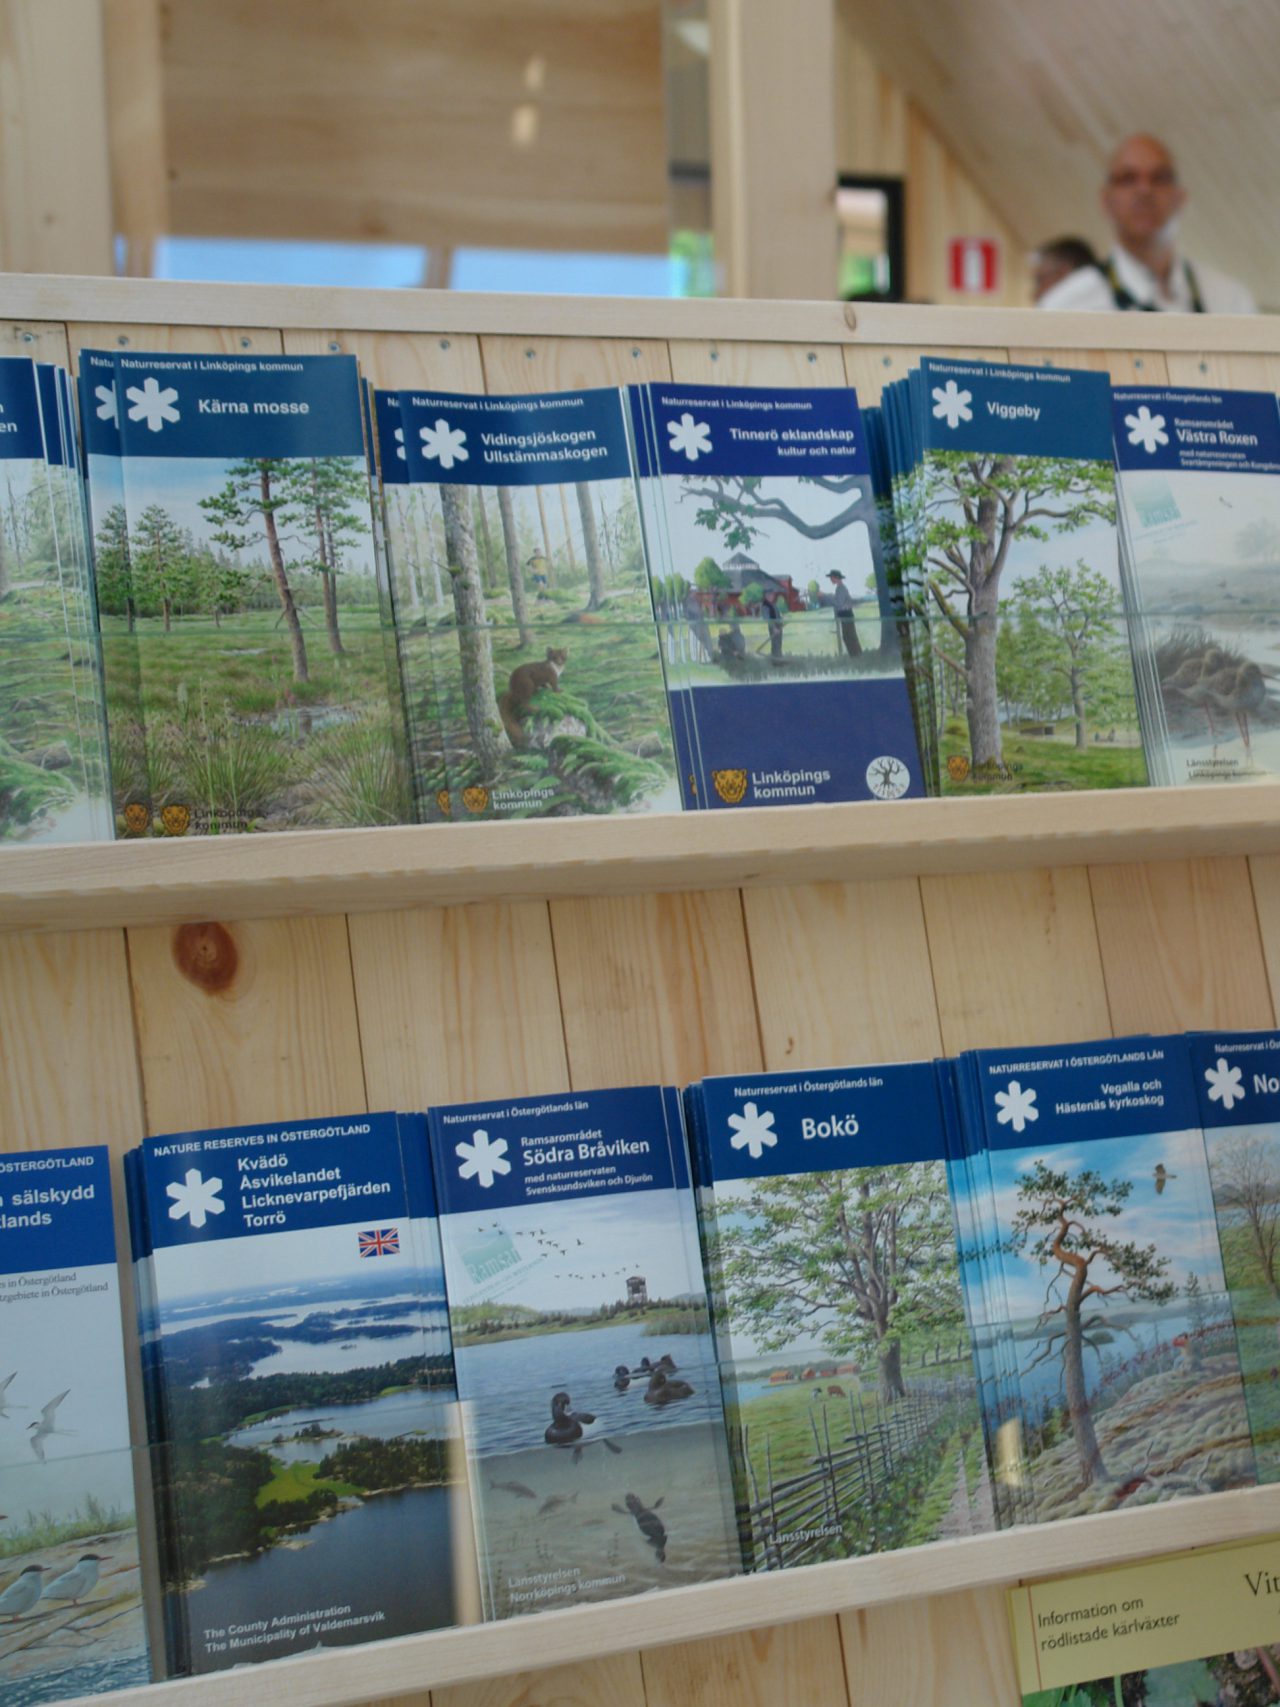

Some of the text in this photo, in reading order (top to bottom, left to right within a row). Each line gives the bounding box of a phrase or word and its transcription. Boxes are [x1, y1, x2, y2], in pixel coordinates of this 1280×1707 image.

[121, 358, 192, 371] Naturreservat
[200, 360, 258, 374] Linköpings
[260, 361, 304, 372] kommun
[928, 362, 984, 376] Naturreservat
[199, 398, 310, 415] Kärna mosse
[412, 397, 479, 411] Naturreservat
[484, 399, 539, 413] Linköpings
[540, 397, 584, 409] kommun
[661, 396, 720, 408] Naturreservat
[726, 400, 773, 412] Linköpings
[775, 401, 813, 410] kommun
[986, 400, 1041, 422] Viggeby
[481, 430, 596, 448] Vidingsjöskogen
[730, 428, 854, 443] Tinnerö eklandskap
[1176, 429, 1258, 447] Västra Roxen
[484, 446, 609, 464] Ullstämmaskogen
[777, 445, 857, 457] kultur och natur
[752, 769, 831, 786] Linköpings
[492, 787, 555, 802] Linköpings
[754, 785, 815, 799] kommun
[493, 800, 543, 811] kommun
[1215, 1042, 1264, 1054] Naturreservat
[988, 1059, 1064, 1076] NATURRESERVAT
[1070, 1051, 1145, 1069] ÖSTERGÖTLANDS
[1147, 1050, 1165, 1061] LÄN
[733, 1084, 798, 1099] Naturreservat
[803, 1077, 868, 1094] Östergötlands
[868, 1076, 884, 1088] län
[1101, 1078, 1162, 1097] Vegalla och
[442, 1110, 505, 1126] Naturreservat
[511, 1102, 574, 1119] Östergötlands
[575, 1100, 589, 1110] län
[1055, 1094, 1165, 1116] Hästenäs kyrkoskog
[801, 1114, 860, 1141] Bokö
[153, 1124, 371, 1158] NATURE RESERVES IN ÖSTERGÖTLAND
[520, 1128, 603, 1147] Ramsarområdet
[237, 1153, 289, 1172] Kvädö
[523, 1138, 650, 1168] Södra Bråviken
[524, 1165, 616, 1184] med naturreservaten
[526, 1172, 654, 1198] Svensksundsviken och Djurön
[12, 1184, 95, 1207] sälskydd
[241, 1182, 391, 1211] Licknevarpefjärden
[243, 1211, 287, 1229] Torrö
[18, 1272, 77, 1287] Östergötland
[51, 1281, 109, 1297] Östergötland
[508, 1567, 581, 1588] Länsstyrelsen
[510, 1573, 626, 1604] Norrköpings kommun
[203, 1603, 351, 1640] The County Administration
[1038, 1598, 1144, 1630] Information om
[204, 1610, 385, 1654] The Municipality of Valdemarsvik
[1041, 1613, 1181, 1652] rödlistade kärlväxter
